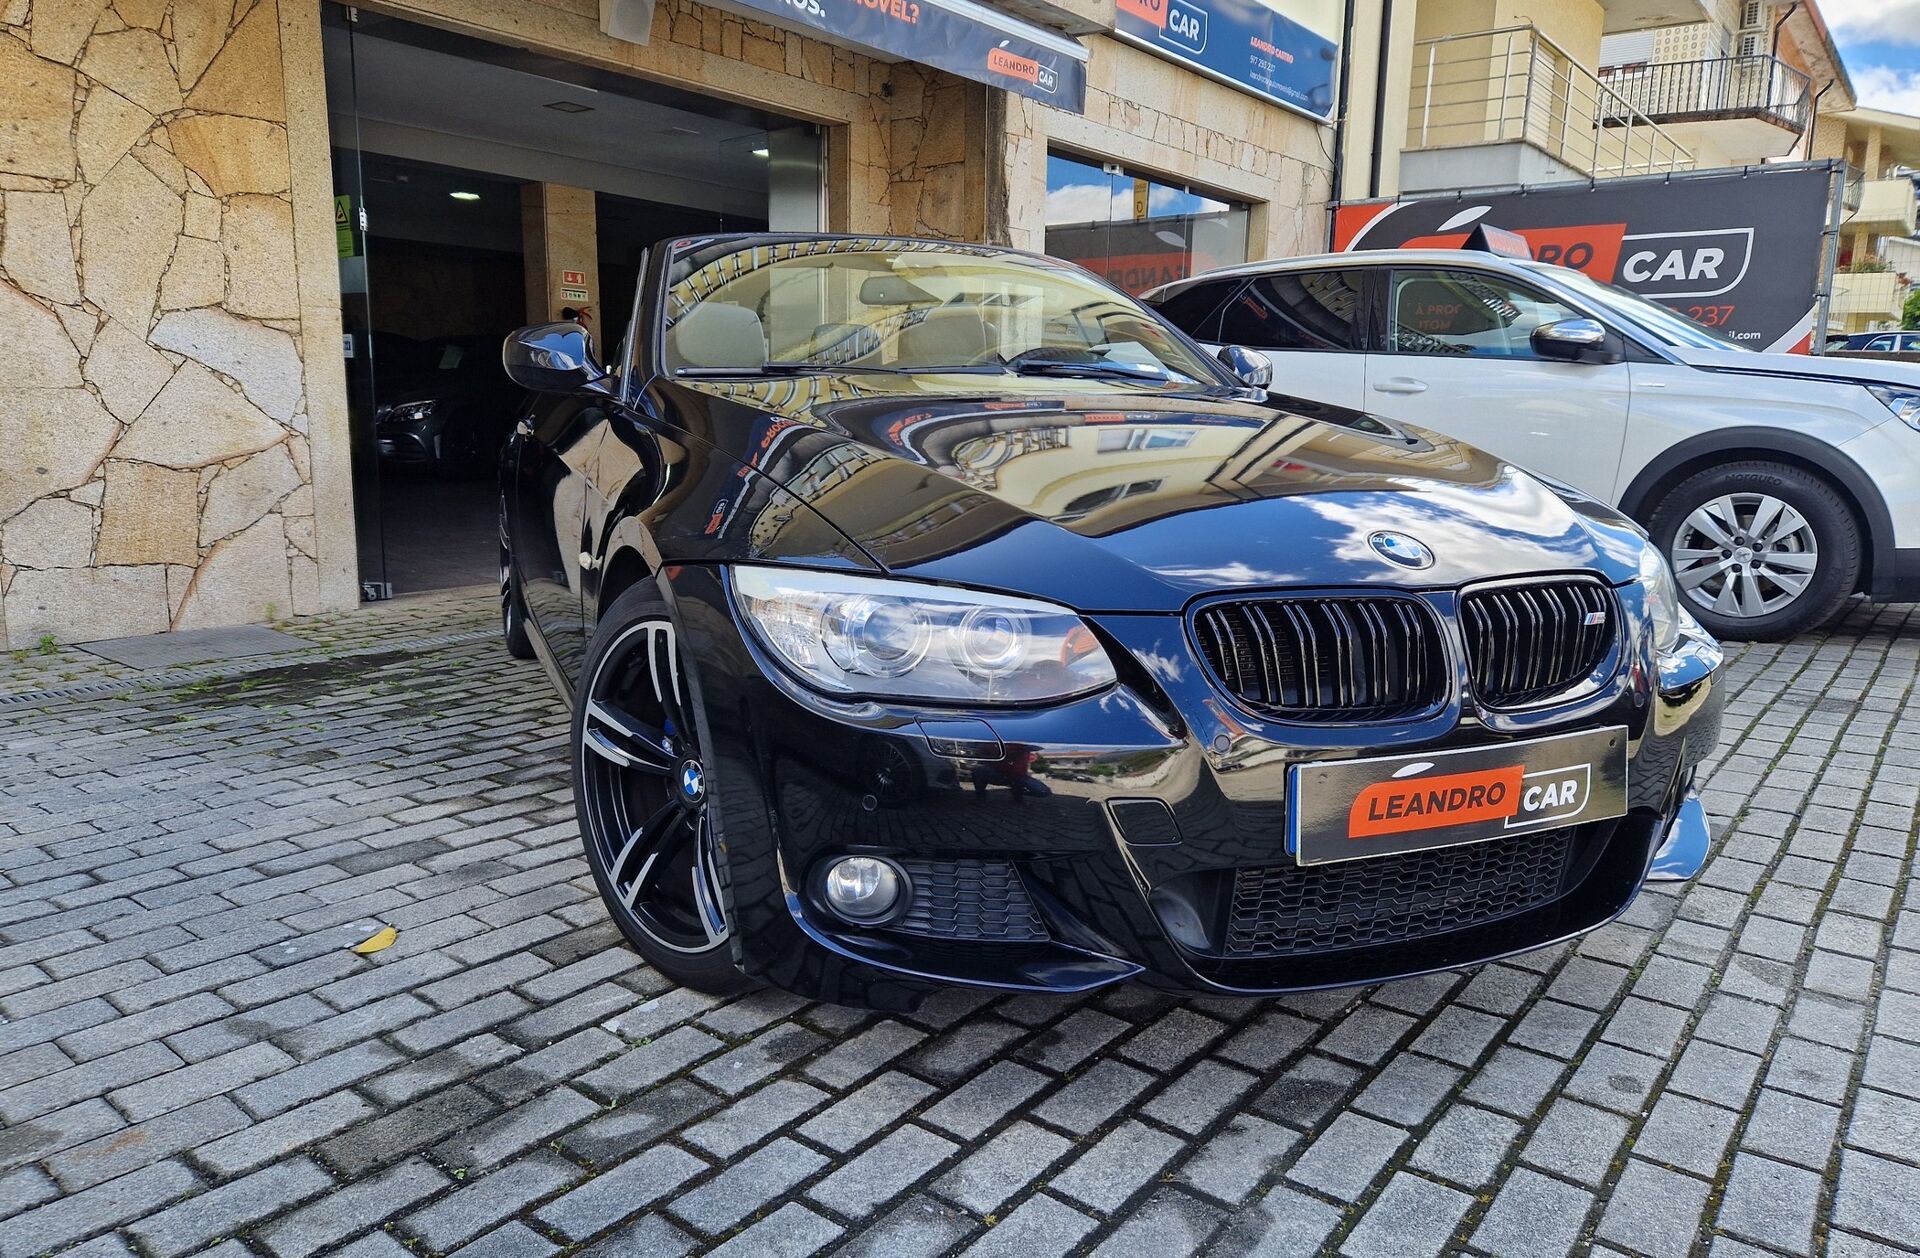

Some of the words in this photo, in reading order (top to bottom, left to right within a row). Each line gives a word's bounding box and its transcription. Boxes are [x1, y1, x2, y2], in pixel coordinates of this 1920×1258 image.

[1169, 9, 1200, 41] CAR
[993, 55, 1035, 75] LEANDRO
[1039, 71, 1053, 87] CAR
[1623, 247, 1724, 283] CAR
[1724, 473, 1783, 487] Norauto
[1368, 782, 1507, 821] LEANDRO
[1523, 779, 1578, 813] CAR
